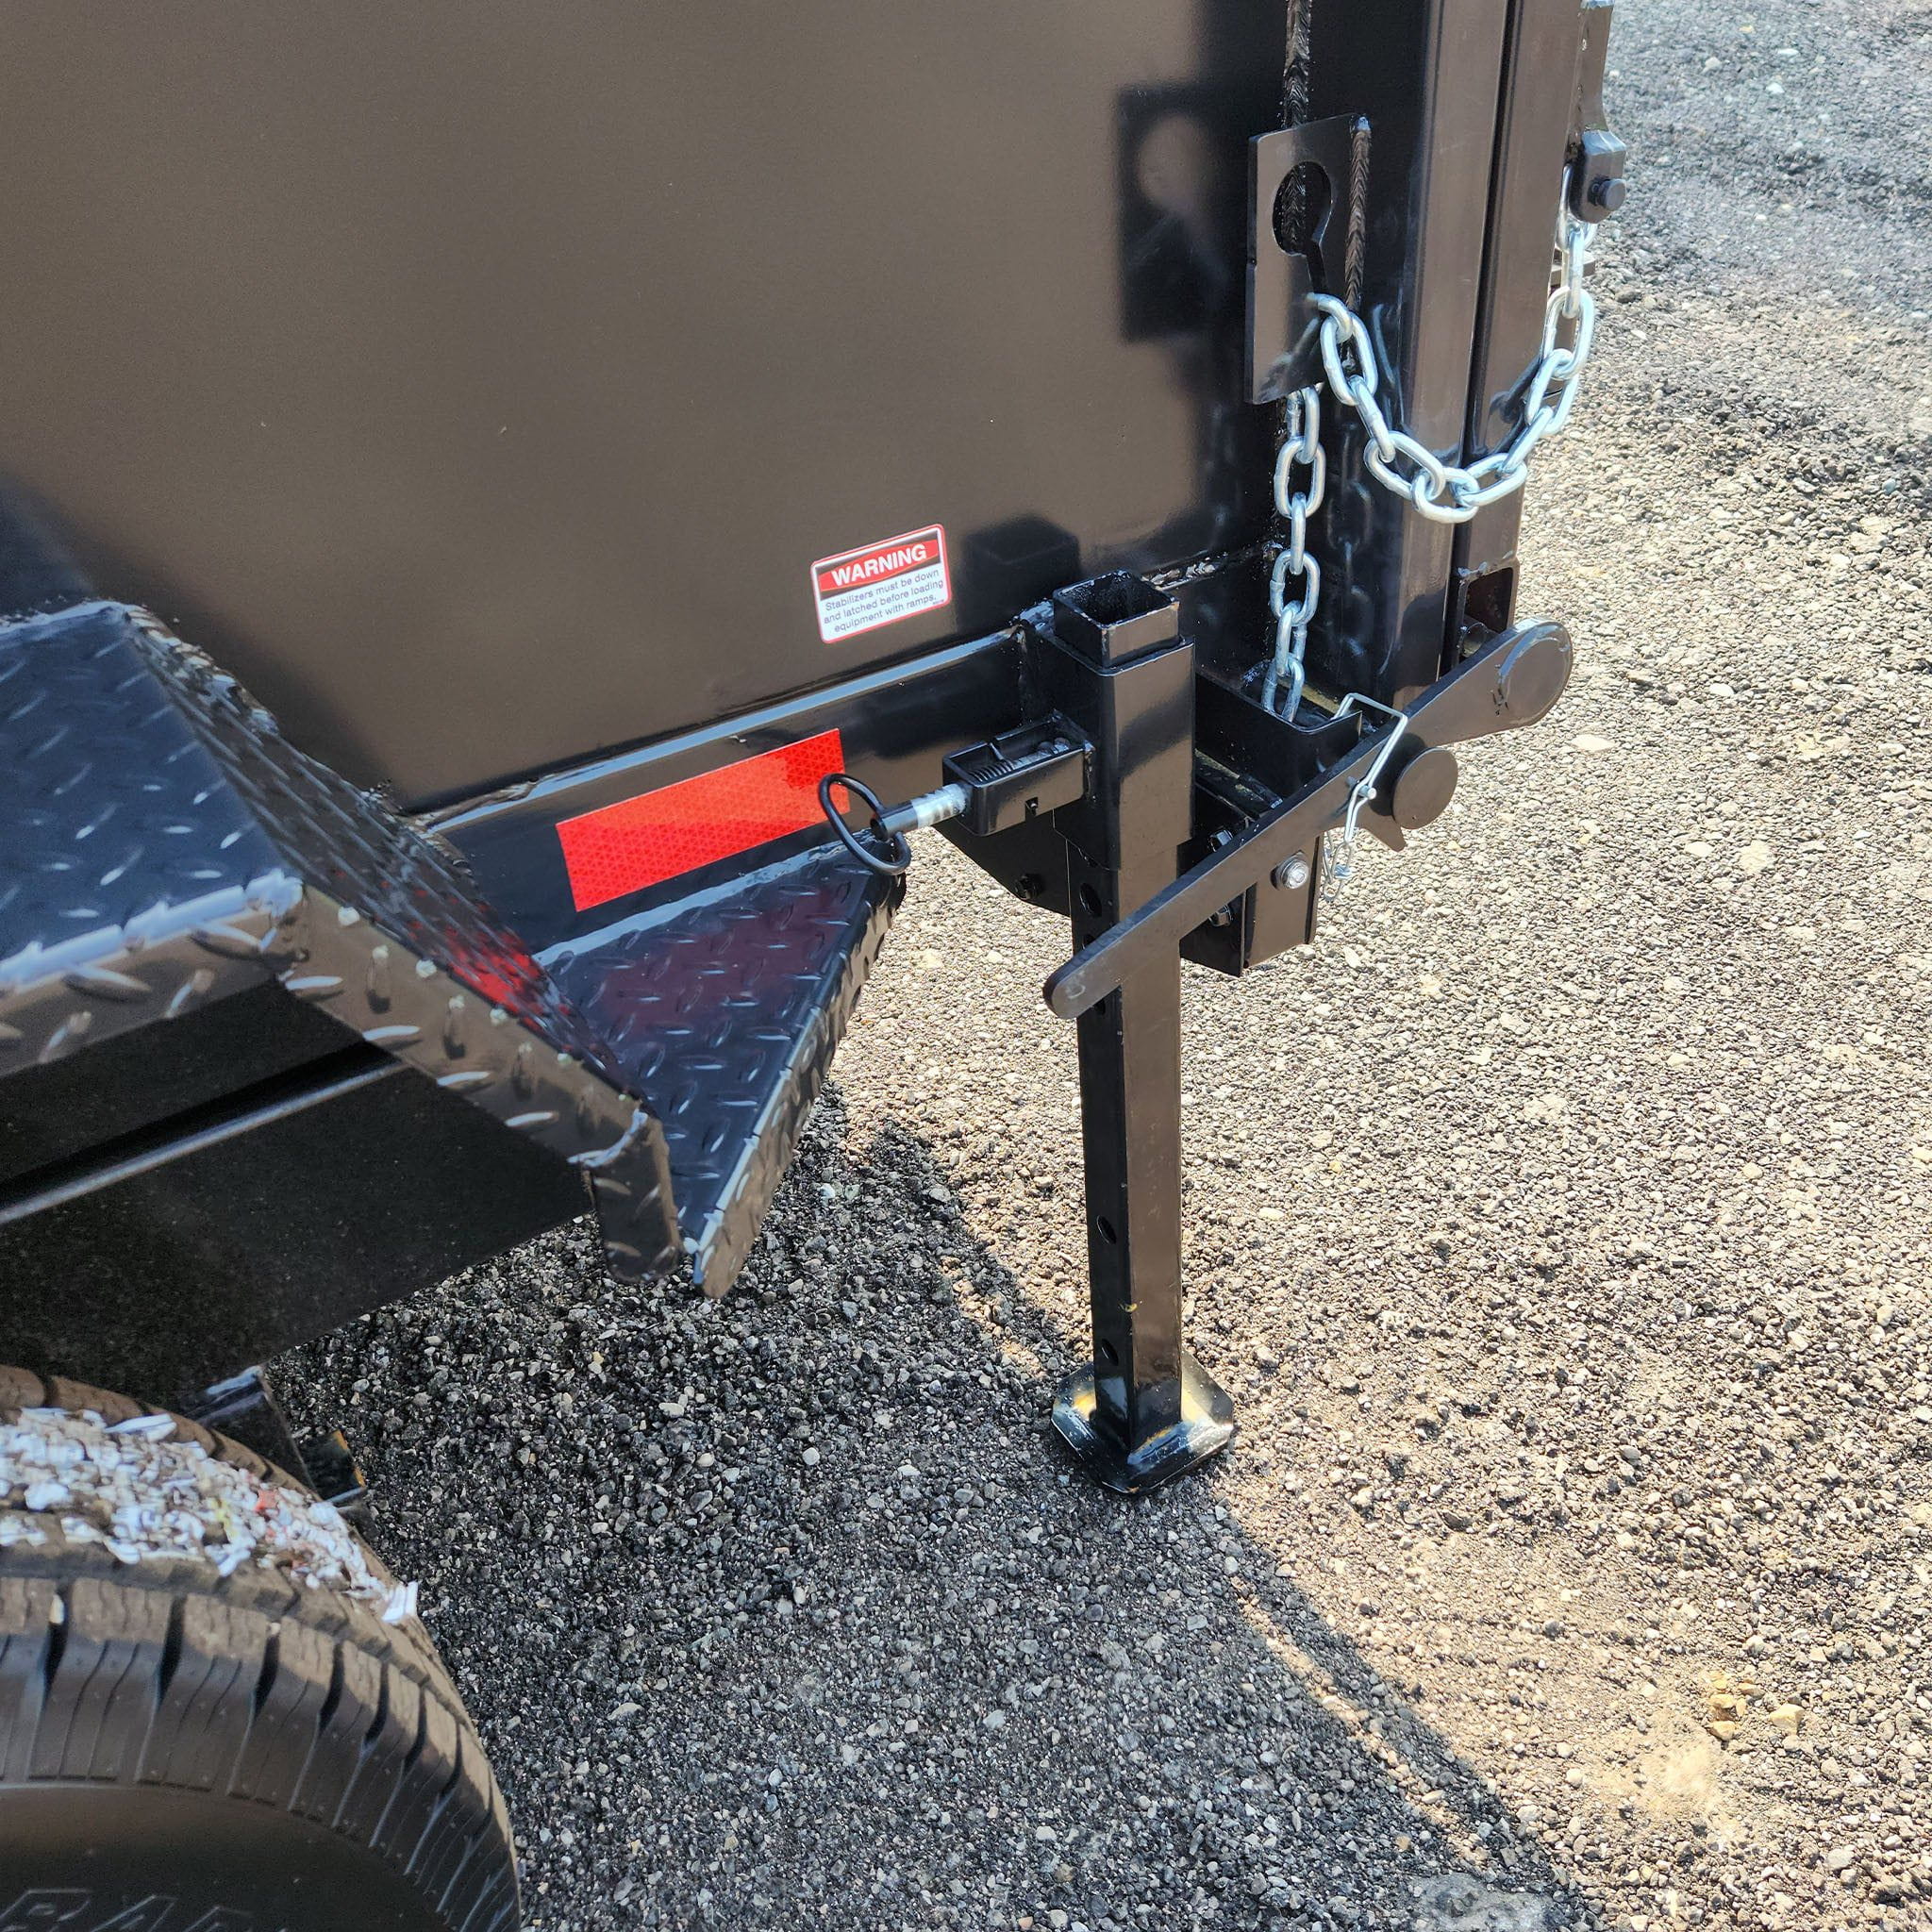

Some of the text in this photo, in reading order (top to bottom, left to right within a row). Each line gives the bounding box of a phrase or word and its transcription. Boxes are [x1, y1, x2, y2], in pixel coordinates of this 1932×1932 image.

[831, 543, 926, 587] WARNING
[824, 579, 943, 625] and latched before loading
[825, 570, 940, 611] Stabilizers must be down
[834, 611, 883, 632] equipment
[886, 604, 904, 616] with
[907, 595, 937, 610] ramps.
